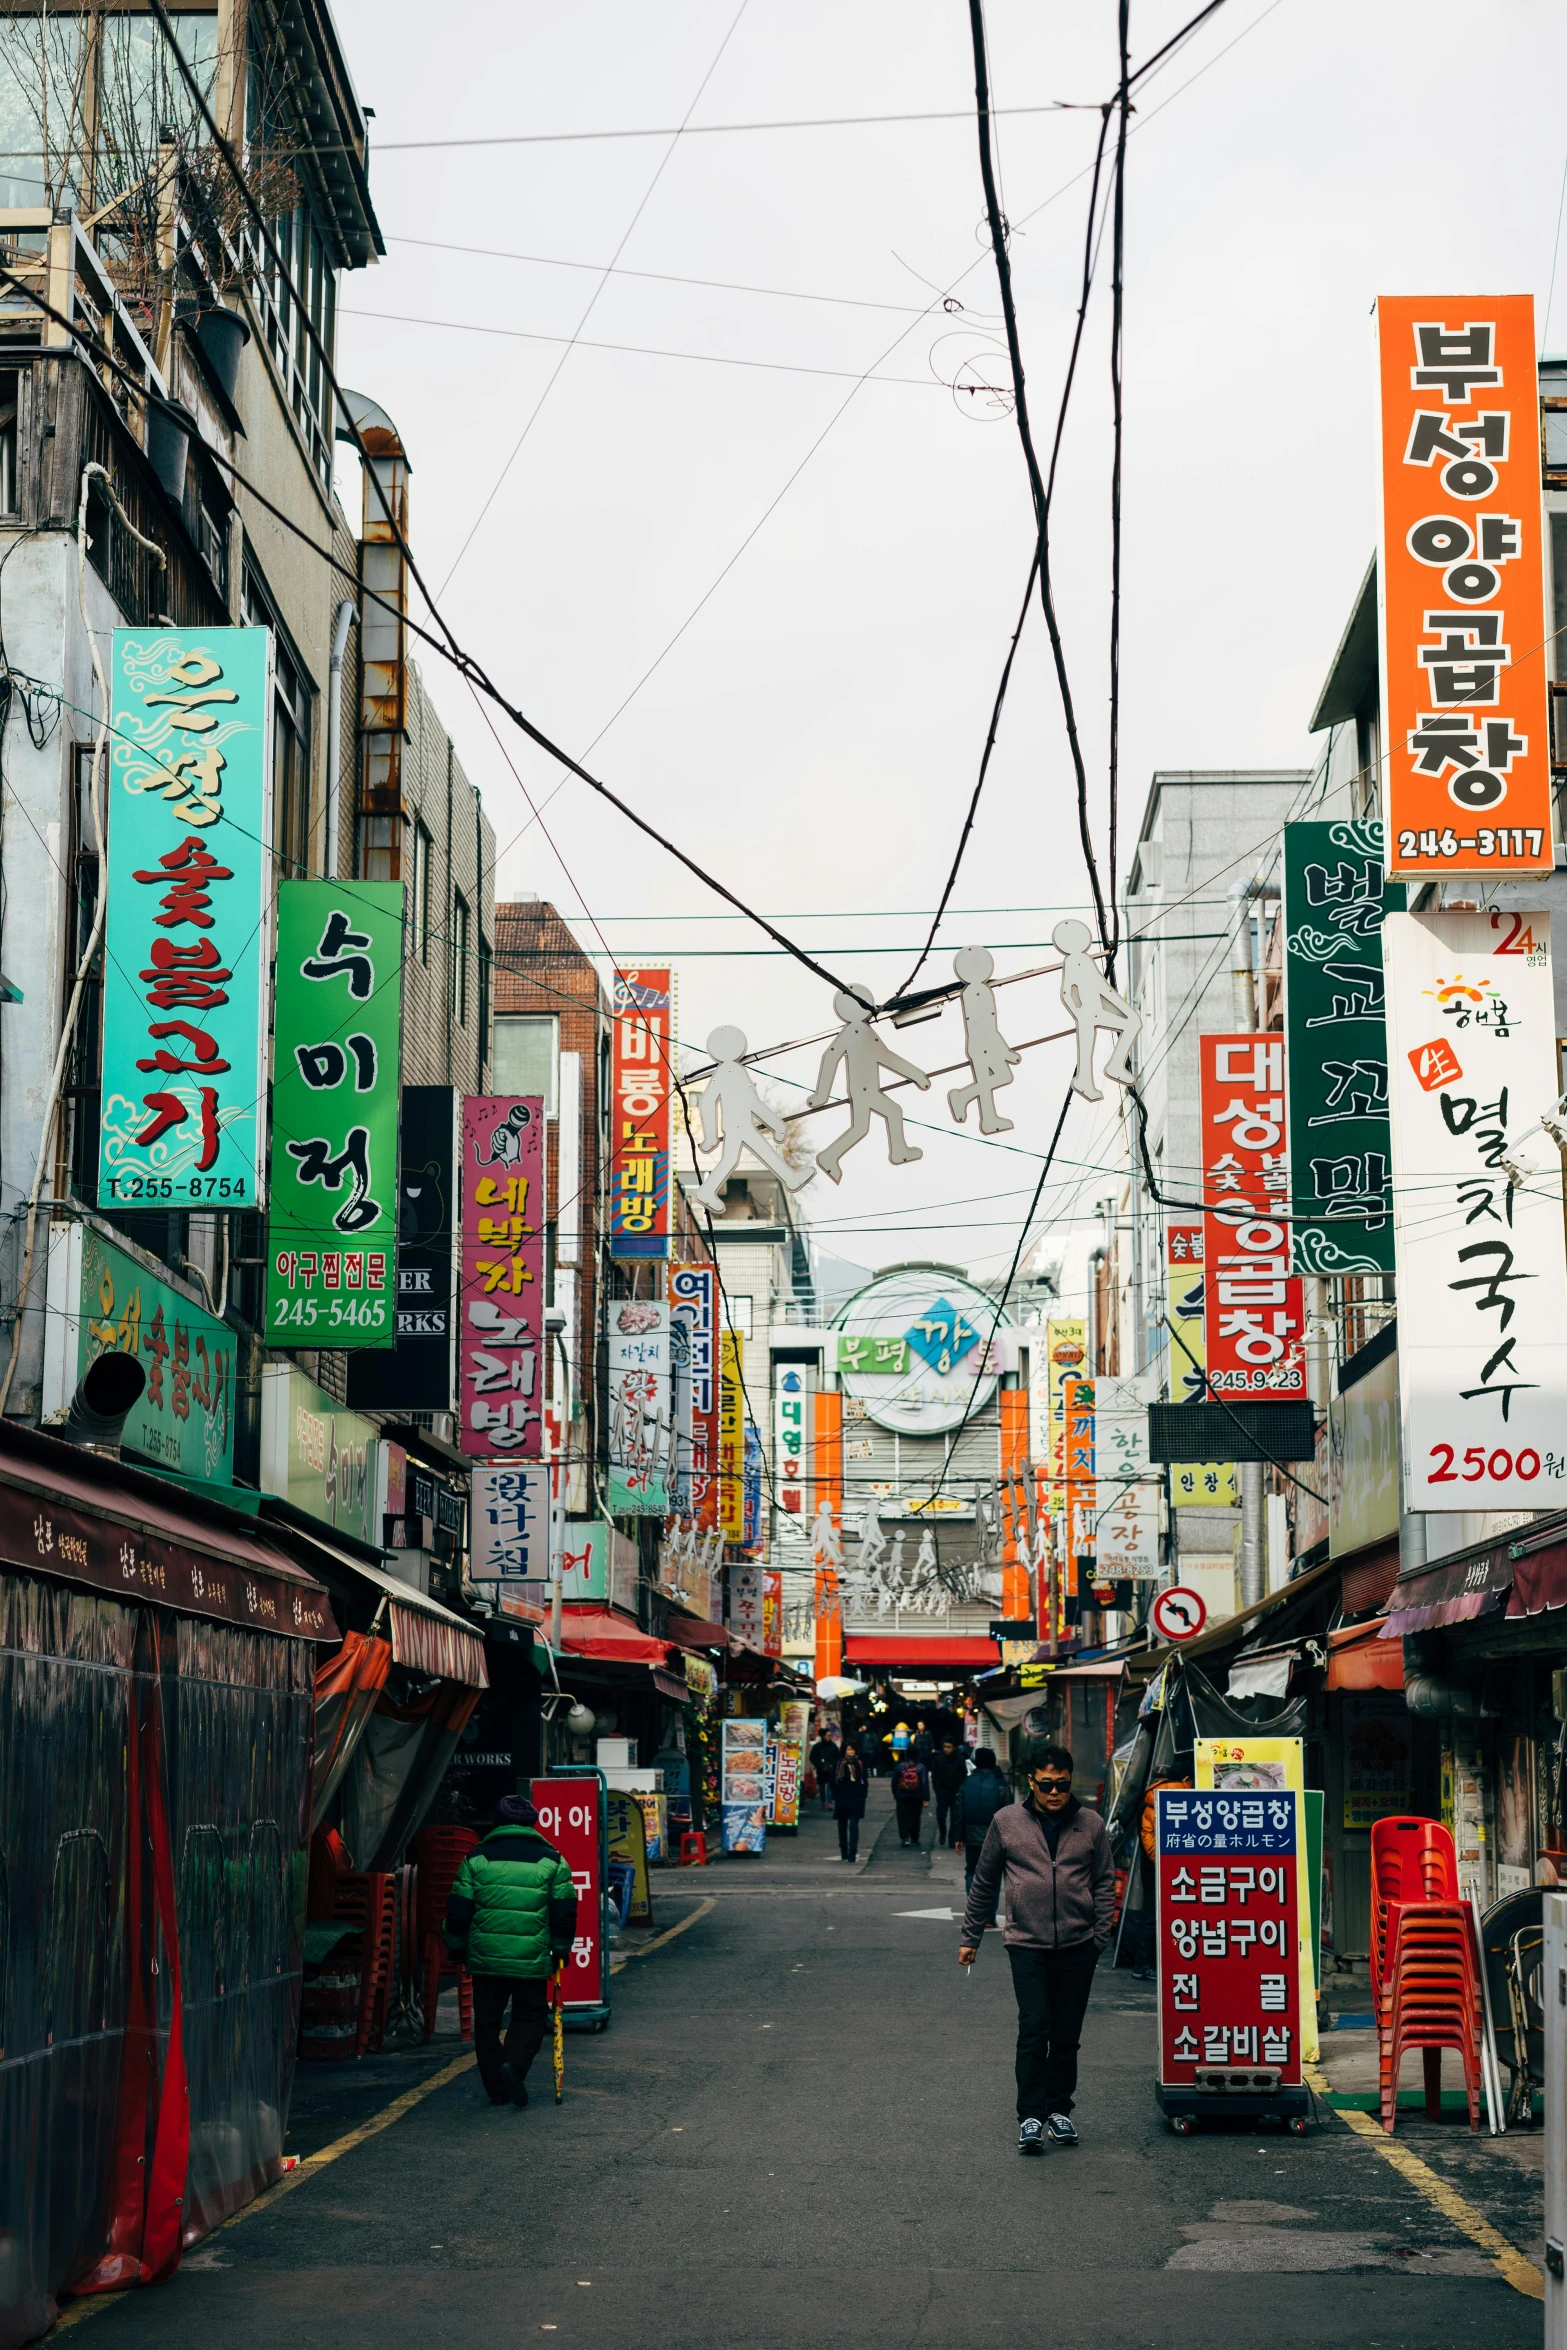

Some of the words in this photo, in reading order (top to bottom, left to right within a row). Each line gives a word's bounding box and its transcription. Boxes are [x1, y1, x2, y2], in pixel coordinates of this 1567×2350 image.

[1403, 321, 1528, 811] 부성양곱창
[1399, 828, 1544, 858] 246-3117
[1526, 955, 1547, 967] 영업
[618, 1016, 665, 1117] 비룡
[1420, 1047, 1459, 1086] 生
[1213, 1043, 1284, 1150] 대성
[106, 1177, 246, 1199] T.255-8754
[618, 1121, 658, 1232] 노래방
[475, 1176, 535, 1296] 네박자
[1440, 1086, 1541, 1423] 멸치국수
[274, 1298, 386, 1328] 245-5465
[621, 1342, 660, 1362] 자갈치
[840, 1337, 907, 1373] 부평
[466, 1301, 541, 1450] 노래방
[142, 1423, 182, 1463] T.255-8754
[1072, 1415, 1096, 1476] 까치
[1428, 1443, 1567, 1484] 2500원
[1111, 1492, 1143, 1551] 공장
[1102, 1564, 1154, 1576] 248-8253
[464, 1753, 512, 1765] WORKS
[778, 1752, 797, 1804] 노래방
[1165, 1799, 1292, 1831] 부성양곱창
[1165, 1833, 1292, 1849] 府省の量ホルモン
[1170, 1866, 1287, 1904] 소금구이
[1170, 1918, 1287, 1959] 양념구이
[1173, 2025, 1291, 2063] 소갈비살
